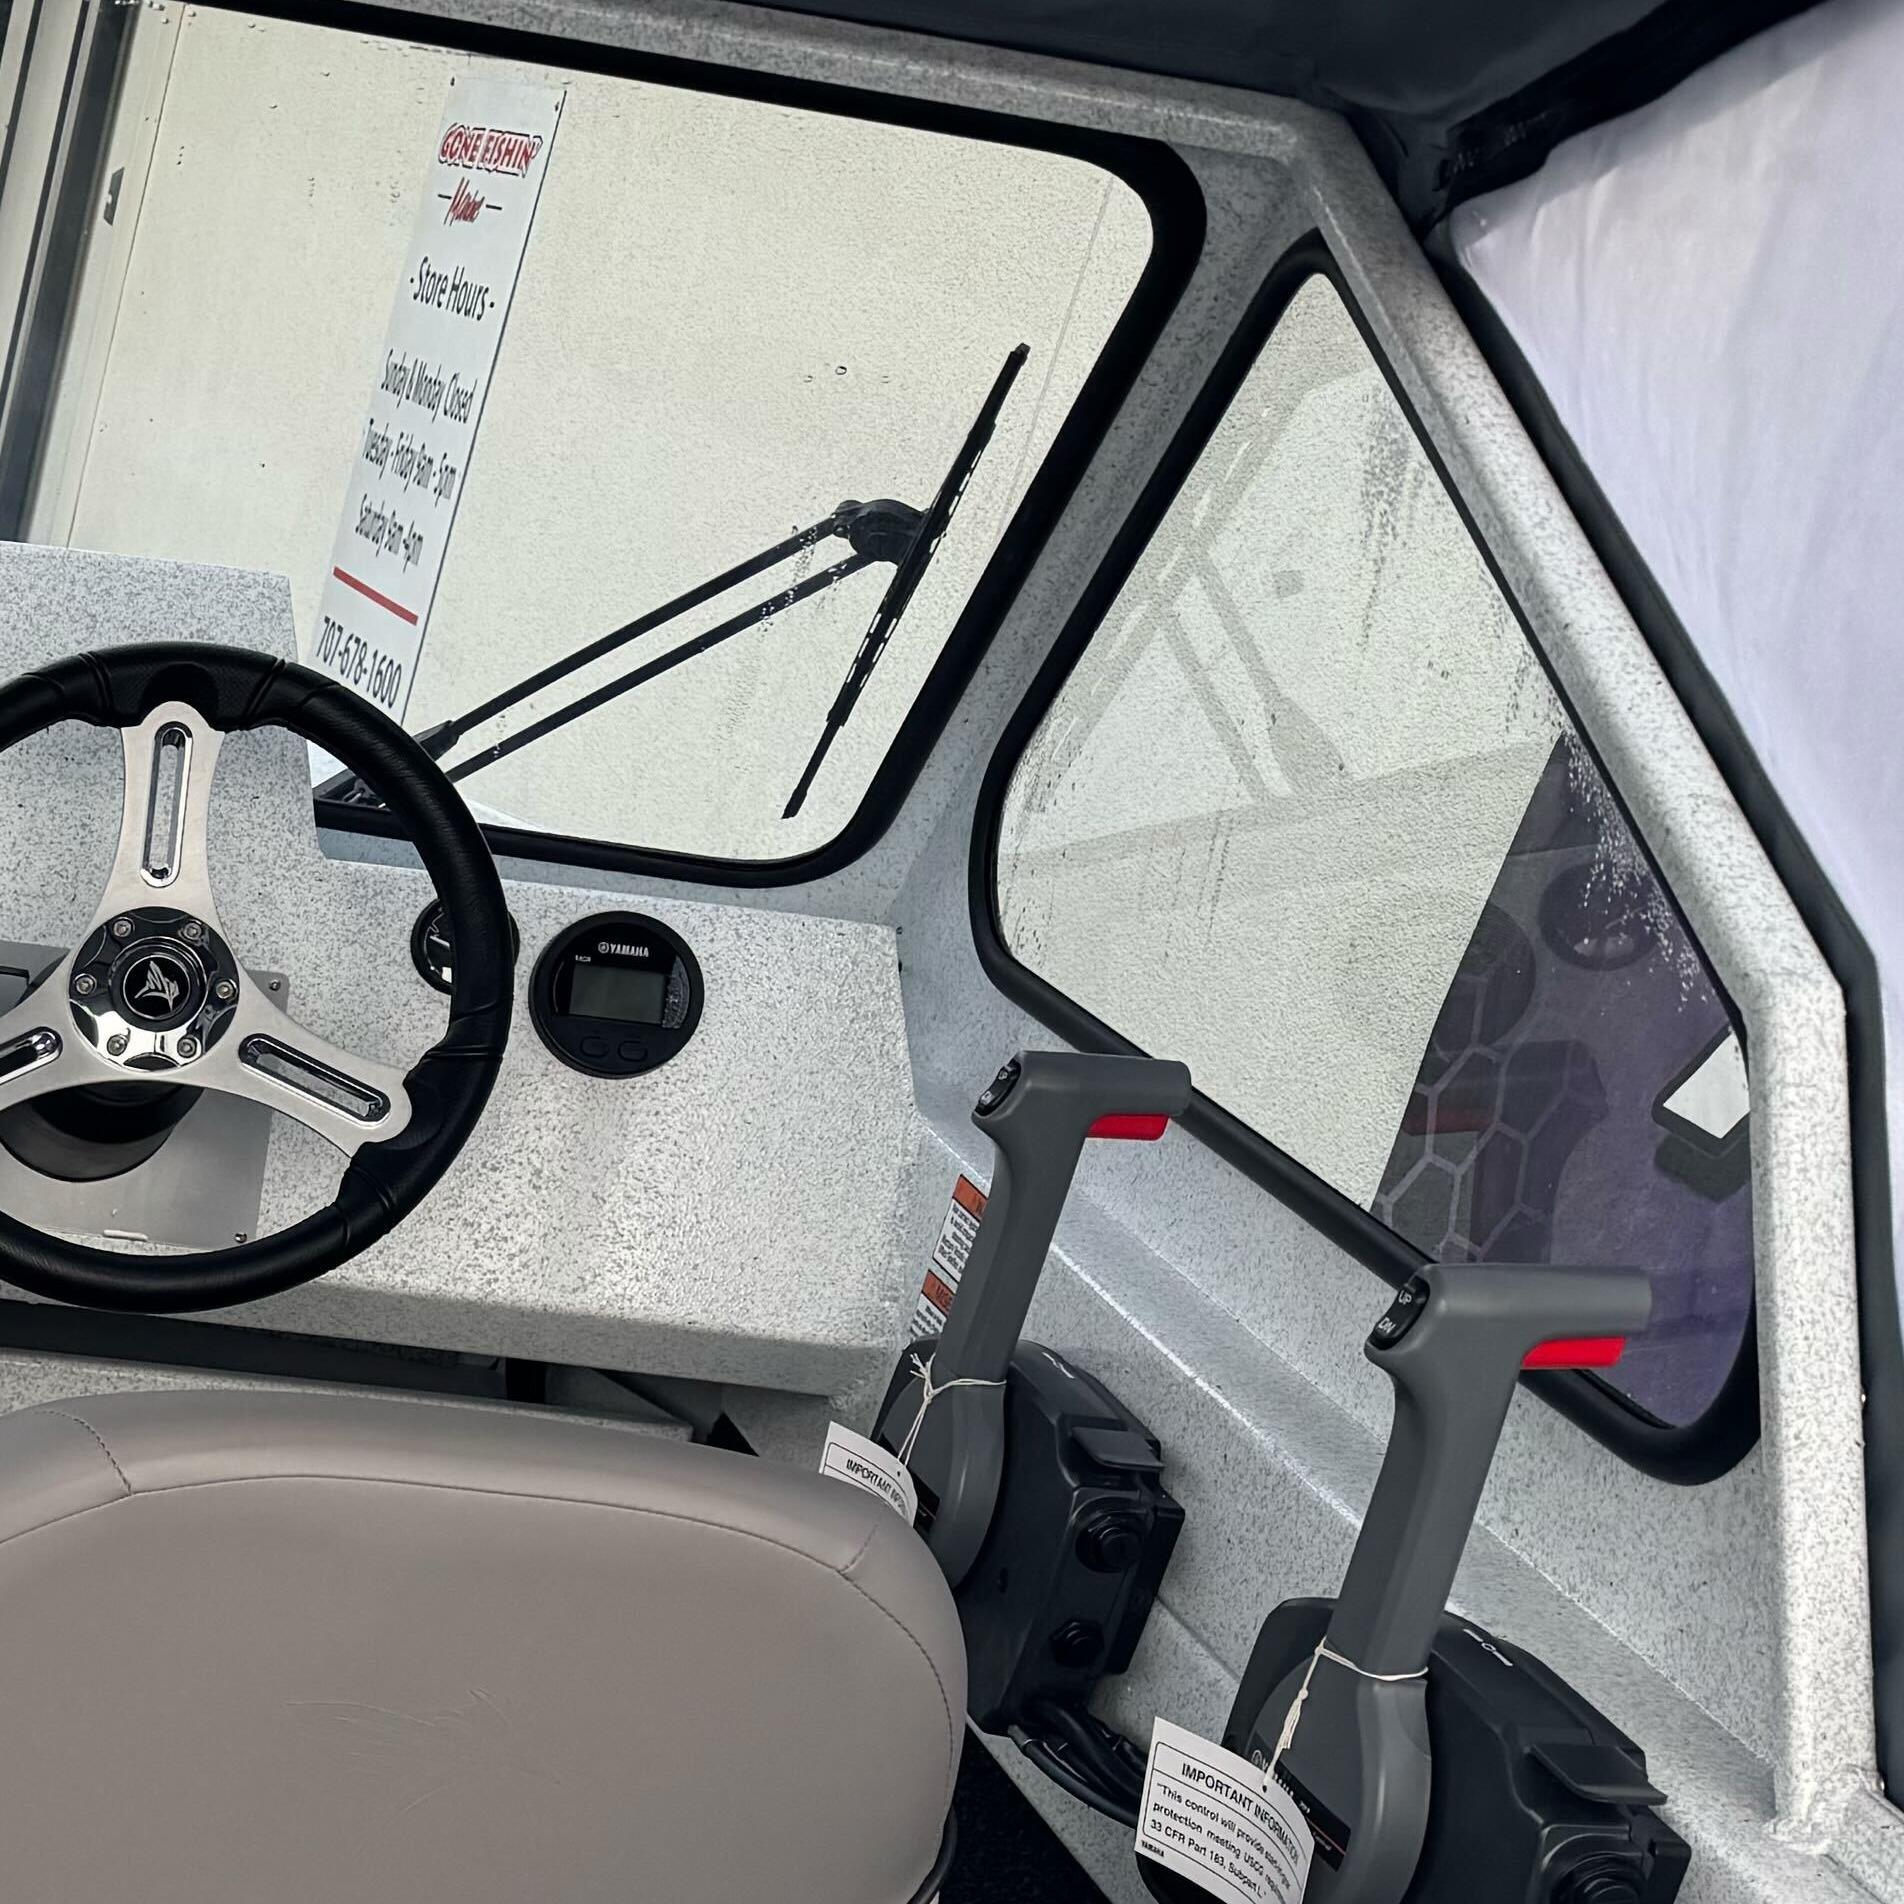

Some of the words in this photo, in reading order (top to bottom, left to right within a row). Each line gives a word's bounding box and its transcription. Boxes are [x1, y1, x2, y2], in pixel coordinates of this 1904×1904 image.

[439, 123, 485, 169] GONE
[443, 372, 478, 424] Closed
[316, 615, 402, 709] 707-678-1600
[610, 943, 649, 957] YAMAHA
[1398, 1290, 1412, 1305] UP
[1182, 1763, 1254, 1811] IMPORTANT
[1151, 1819, 1162, 1832] 33
[1165, 1826, 1185, 1844] CFR
[1188, 1838, 1206, 1856] Part
[1153, 1802, 1202, 1834] protection
[1207, 1830, 1241, 1859] meeting
[1185, 1799, 1219, 1822] control
[1221, 1818, 1237, 1832] will
